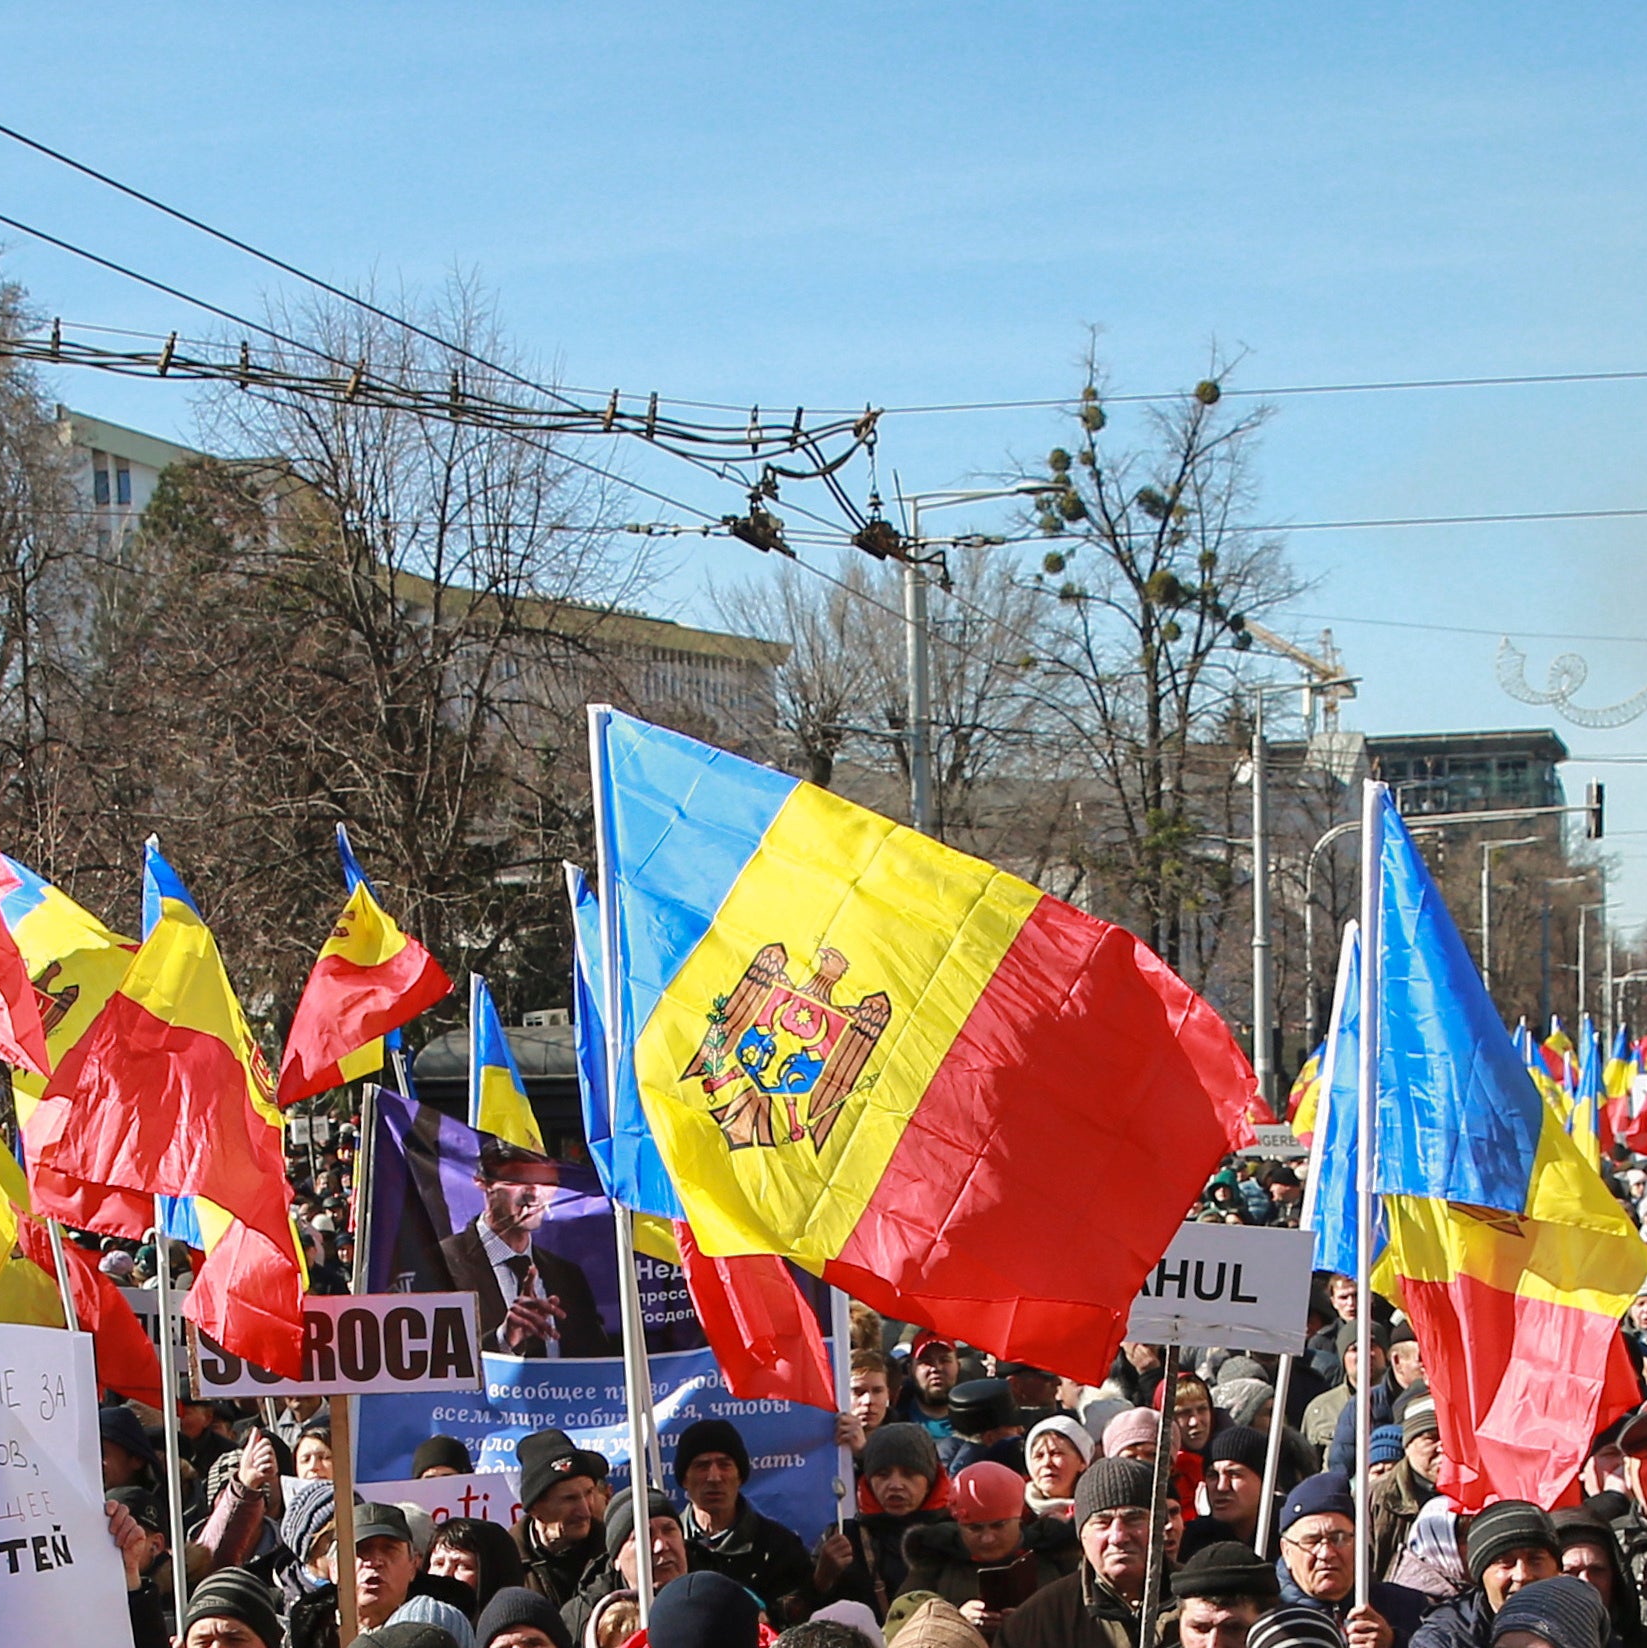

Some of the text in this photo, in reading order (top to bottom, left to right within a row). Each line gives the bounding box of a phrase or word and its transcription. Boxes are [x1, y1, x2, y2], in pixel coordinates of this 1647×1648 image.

[1141, 1258, 1258, 1304] HUL
[201, 1306, 475, 1386] SROCA
[488, 1381, 597, 1400] всеобщее
[432, 1406, 491, 1424] всем
[497, 1413, 556, 1430] мире
